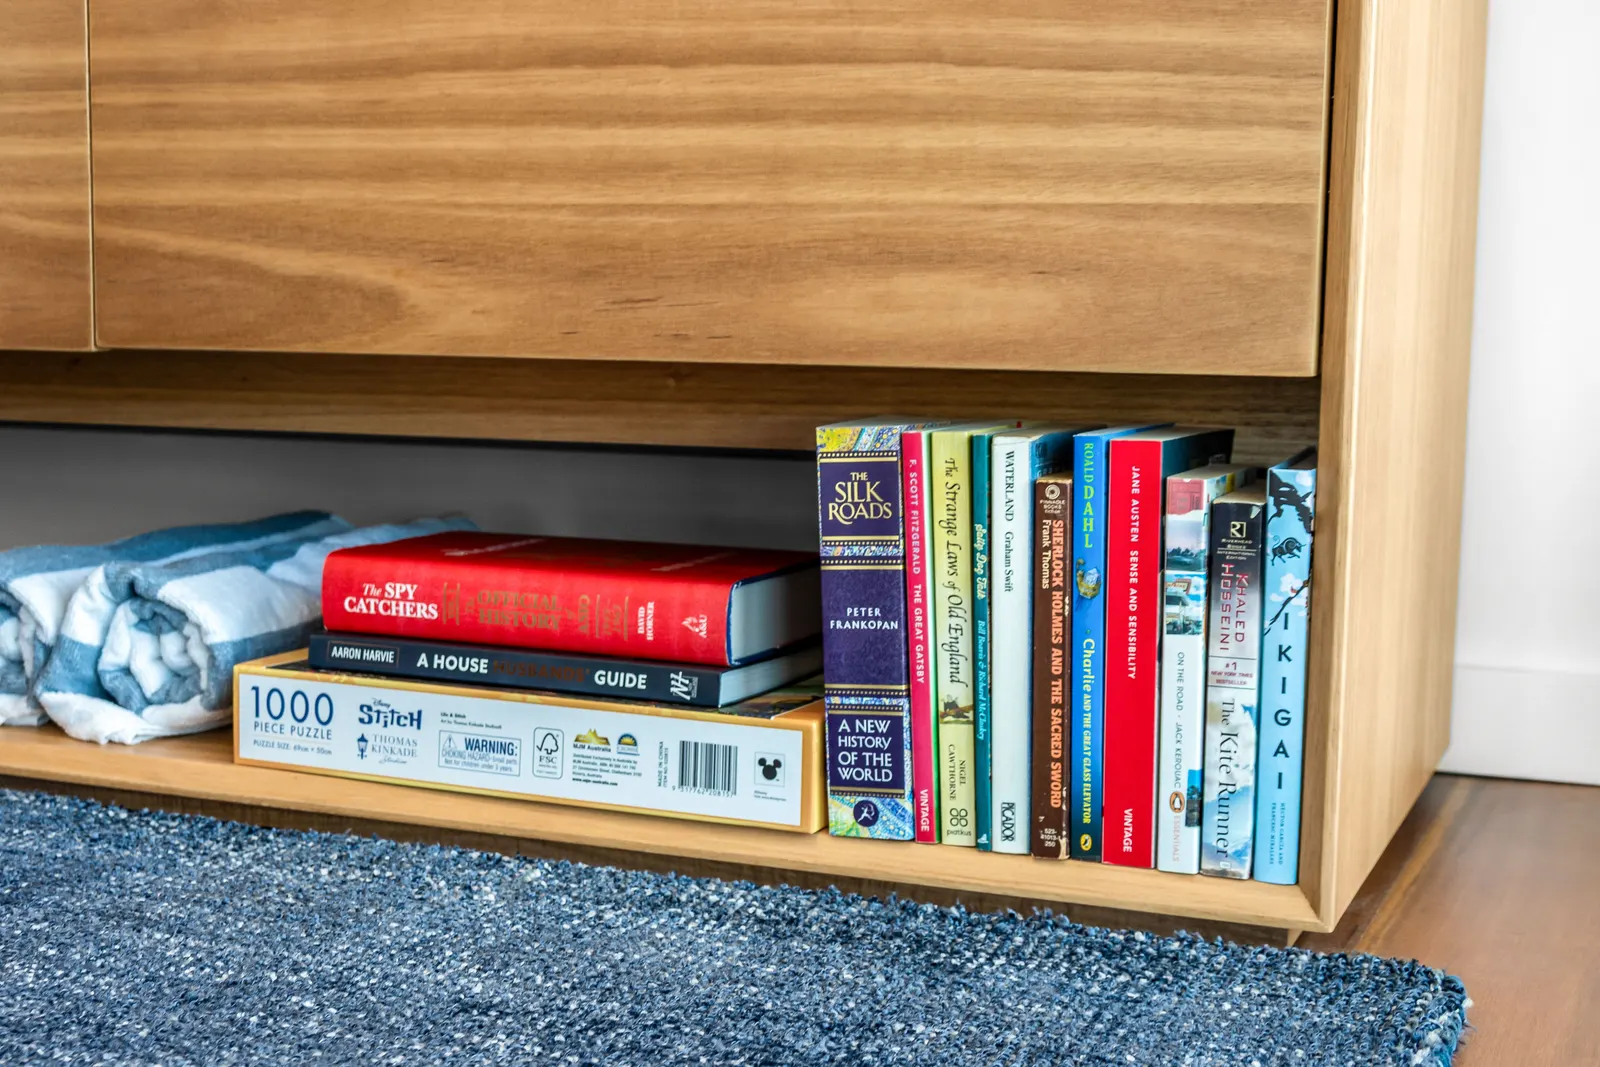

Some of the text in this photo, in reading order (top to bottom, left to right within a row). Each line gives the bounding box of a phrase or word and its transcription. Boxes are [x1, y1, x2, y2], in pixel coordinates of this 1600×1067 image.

[850, 472, 868, 480] THE
[910, 459, 917, 468] F.
[835, 481, 883, 502] SILK
[910, 472, 918, 506] SCOTT
[1083, 443, 1094, 548] ROALD DAHL
[828, 503, 892, 525] ROADS
[1004, 451, 1014, 592] WATERLAND Graham Swift
[911, 510, 920, 574] FITZGERALD
[1042, 520, 1052, 589] Frank Thomas
[1052, 520, 1064, 587] SHERLOCK
[939, 458, 968, 688] The Strange Laws of Old England
[974, 552, 987, 574] Dog
[1128, 466, 1140, 679] JANE AUSTEN SENSE AND SENSIBILITY
[363, 582, 418, 600] The SPY
[478, 590, 561, 610] OFFICIAL
[976, 577, 987, 600] Talk
[344, 597, 438, 620] CATCHERS
[478, 608, 560, 630] HISTORY
[646, 602, 654, 640] HORNER
[847, 608, 880, 616] PETER
[1052, 591, 1063, 644] HOLMES
[1220, 564, 1234, 650] HOSSEINI
[1235, 574, 1248, 642] KHALED
[830, 620, 898, 630] FRANKOPAN
[914, 608, 923, 640] GREAT
[332, 646, 394, 663] AARON HARVIE
[916, 645, 924, 683] GATSBY
[1052, 648, 1062, 675] AND
[1178, 652, 1184, 666] ON
[416, 652, 428, 668] A
[434, 654, 488, 674] HOUSE
[594, 670, 647, 690] GUIDE
[978, 670, 986, 700] Richard
[1051, 678, 1062, 704] THE
[1273, 612, 1292, 790] IKIGAI
[252, 686, 334, 726] 1000
[254, 722, 332, 740] PIECE PUZZLE
[838, 719, 890, 733] A NEW
[1051, 708, 1062, 758] SACRED
[1083, 638, 1095, 824] Charlie AND THE GREAT GLASS ELEVATOR
[253, 740, 274, 750] PUZZLE
[372, 734, 418, 747] THOMAS
[372, 744, 418, 758] KINKADE
[442, 748, 466, 760] CHOKING
[464, 737, 518, 756] WARNING:
[587, 744, 611, 752] Australia
[838, 736, 892, 750] HISTORY
[838, 752, 892, 766] OF THE
[1174, 748, 1182, 788] KEROUAC
[838, 768, 892, 782] WORLD
[1050, 762, 1062, 808] SWORD
[1216, 698, 1238, 858] The Kite Runner
[920, 789, 930, 832] VINTAGE
[1001, 802, 1016, 842] PICADOR
[1123, 808, 1132, 852] VINTAGE
[1173, 816, 1181, 862] ESSENTIALS
